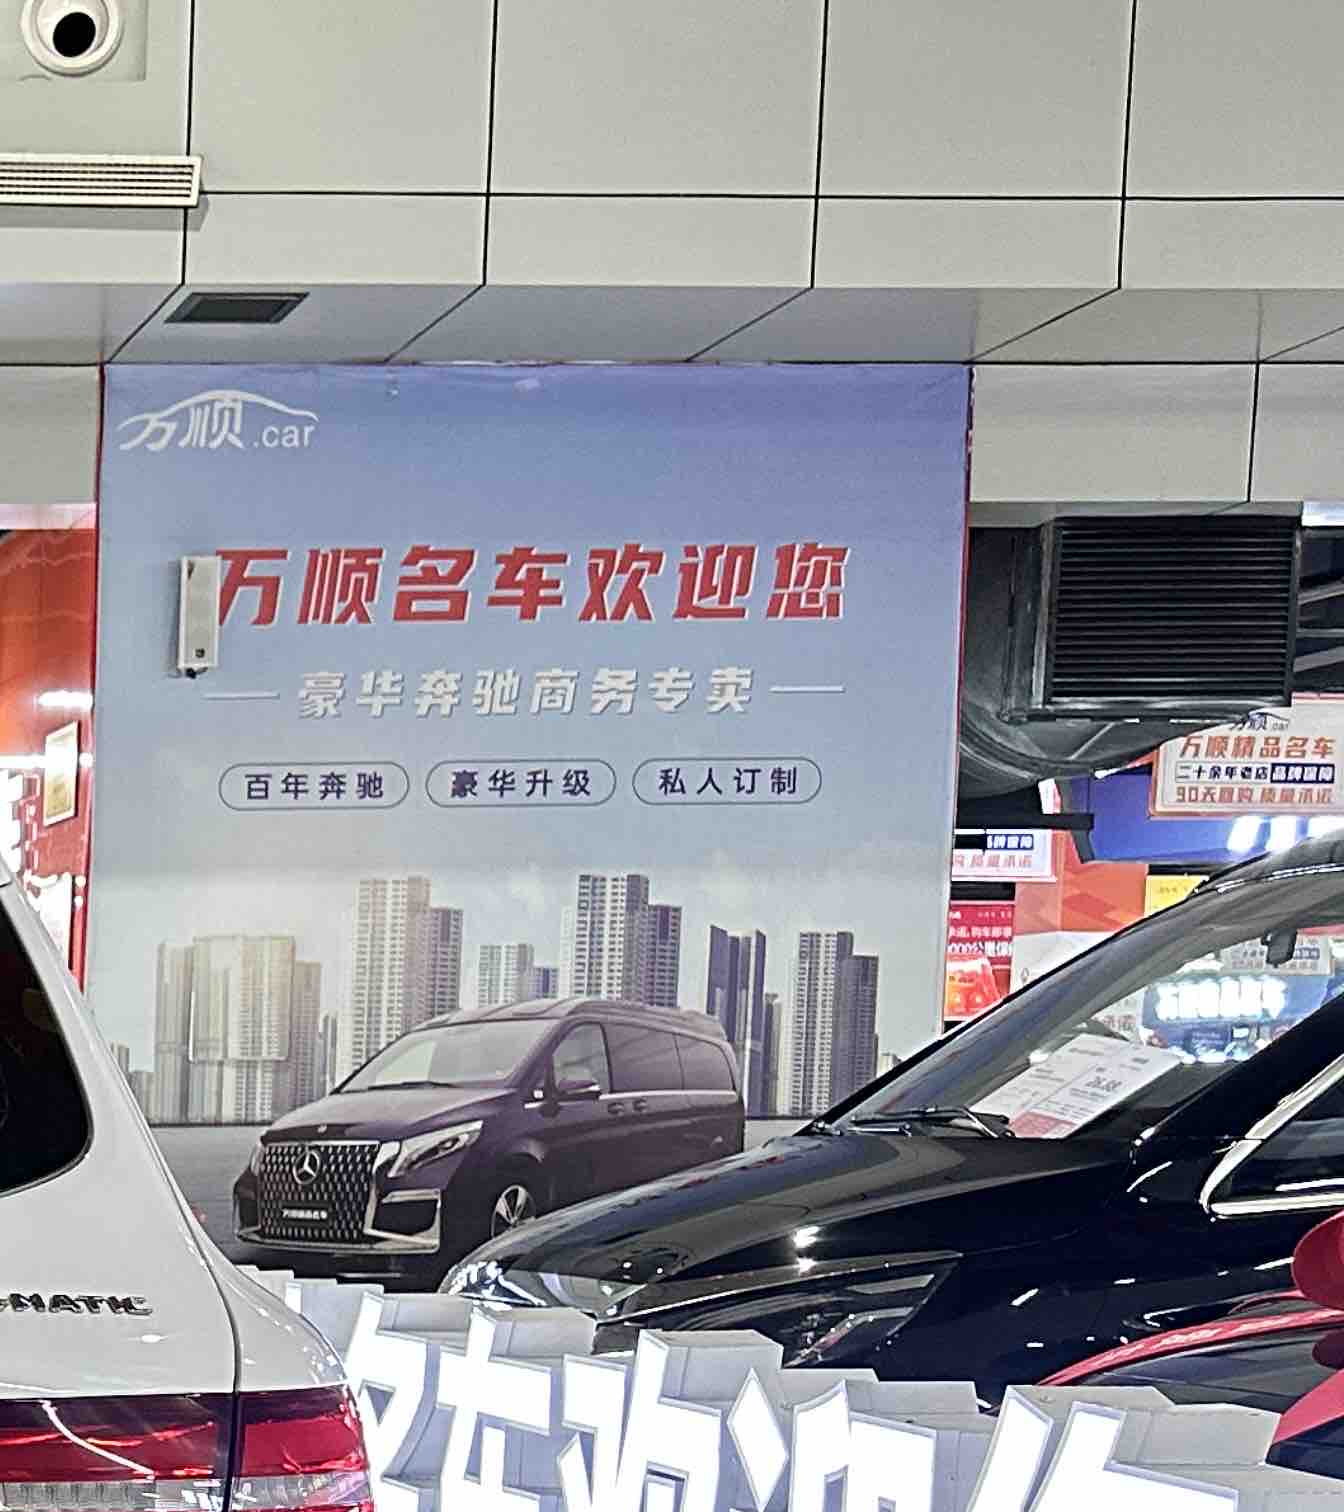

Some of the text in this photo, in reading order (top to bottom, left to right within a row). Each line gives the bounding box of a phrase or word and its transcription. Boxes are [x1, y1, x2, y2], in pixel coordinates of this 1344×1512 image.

[214, 541, 850, 628] 万顺名车欢迎您
[296, 665, 756, 720] 豪华奔驰商务专卖
[1179, 735, 1335, 759] 万顺精品名车
[245, 770, 384, 802] 百年奔驰
[450, 767, 593, 799] 豪华升级
[658, 765, 799, 797] 私人订制
